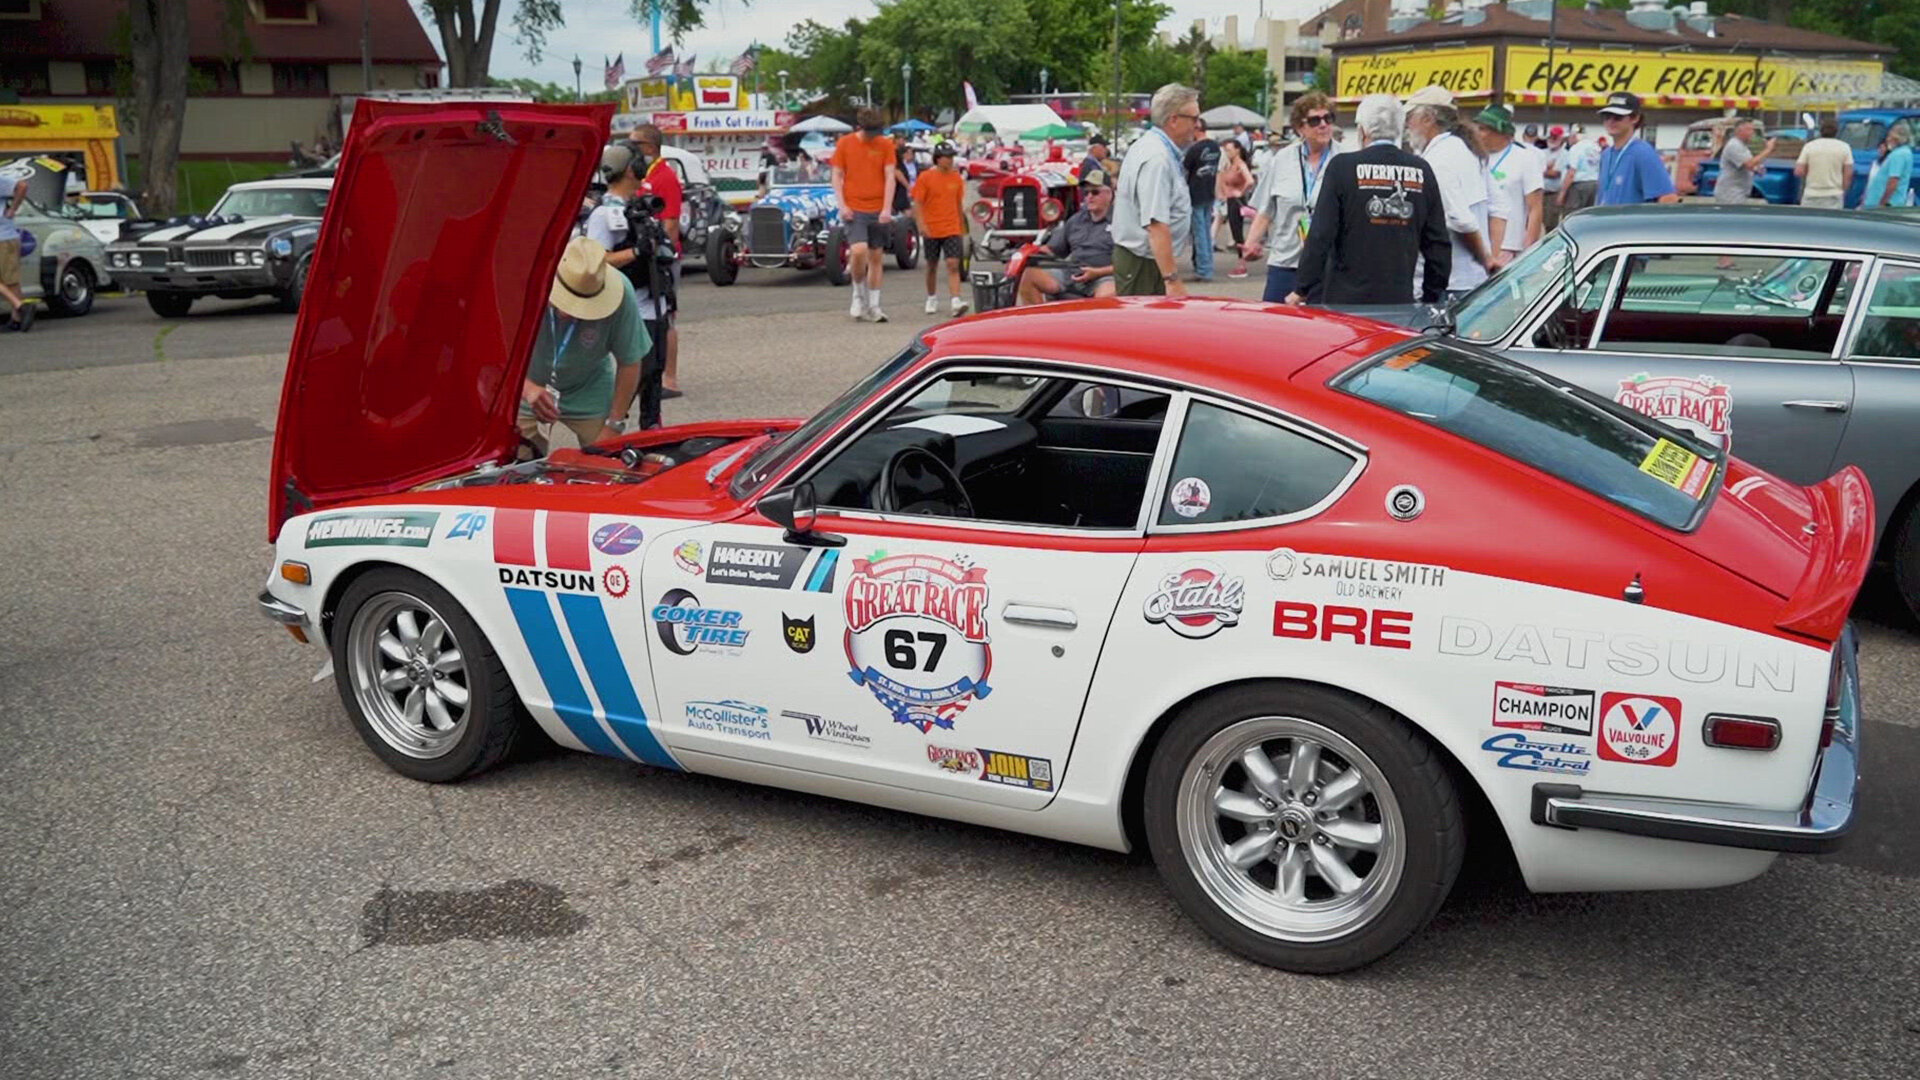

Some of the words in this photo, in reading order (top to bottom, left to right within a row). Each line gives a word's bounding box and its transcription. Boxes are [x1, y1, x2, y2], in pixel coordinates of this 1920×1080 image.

[1362, 56, 1398, 69] FRESH
[1344, 71, 1416, 95] FRENCH
[1426, 68, 1484, 91] FRIES
[1526, 61, 1639, 92] FRESH
[1654, 67, 1776, 96] FRENCH
[694, 116, 721, 127] Fresh
[726, 116, 741, 128] Cut
[746, 116, 769, 127] Fries
[1356, 164, 1424, 184] OVERMYER'S
[1012, 192, 1027, 226] 1
[1678, 395, 1727, 433] RACE
[499, 568, 595, 592] DATSUN
[1302, 558, 1377, 581] SAMUEL
[1384, 564, 1444, 586] SMITH
[1336, 580, 1355, 597] OLD
[1358, 583, 1403, 600] BREWERY
[652, 605, 743, 627] COKER
[846, 576, 920, 631] GREAT
[924, 582, 986, 640] RACE
[684, 625, 749, 647] TIRE
[787, 626, 810, 642] CAT
[1273, 600, 1413, 649] BRE
[884, 629, 947, 672] 67
[1439, 616, 1797, 693] DATSUN
[685, 705, 768, 729] McCollister's
[1499, 697, 1589, 720] CHAMPION
[688, 718, 713, 732] Auto
[716, 722, 771, 741] Transport
[827, 720, 858, 733] Wheel
[1481, 733, 1591, 756] Corvette
[1609, 728, 1665, 749] VALVOLINE
[988, 753, 1028, 780] JOIN
[1497, 750, 1591, 771] Central
